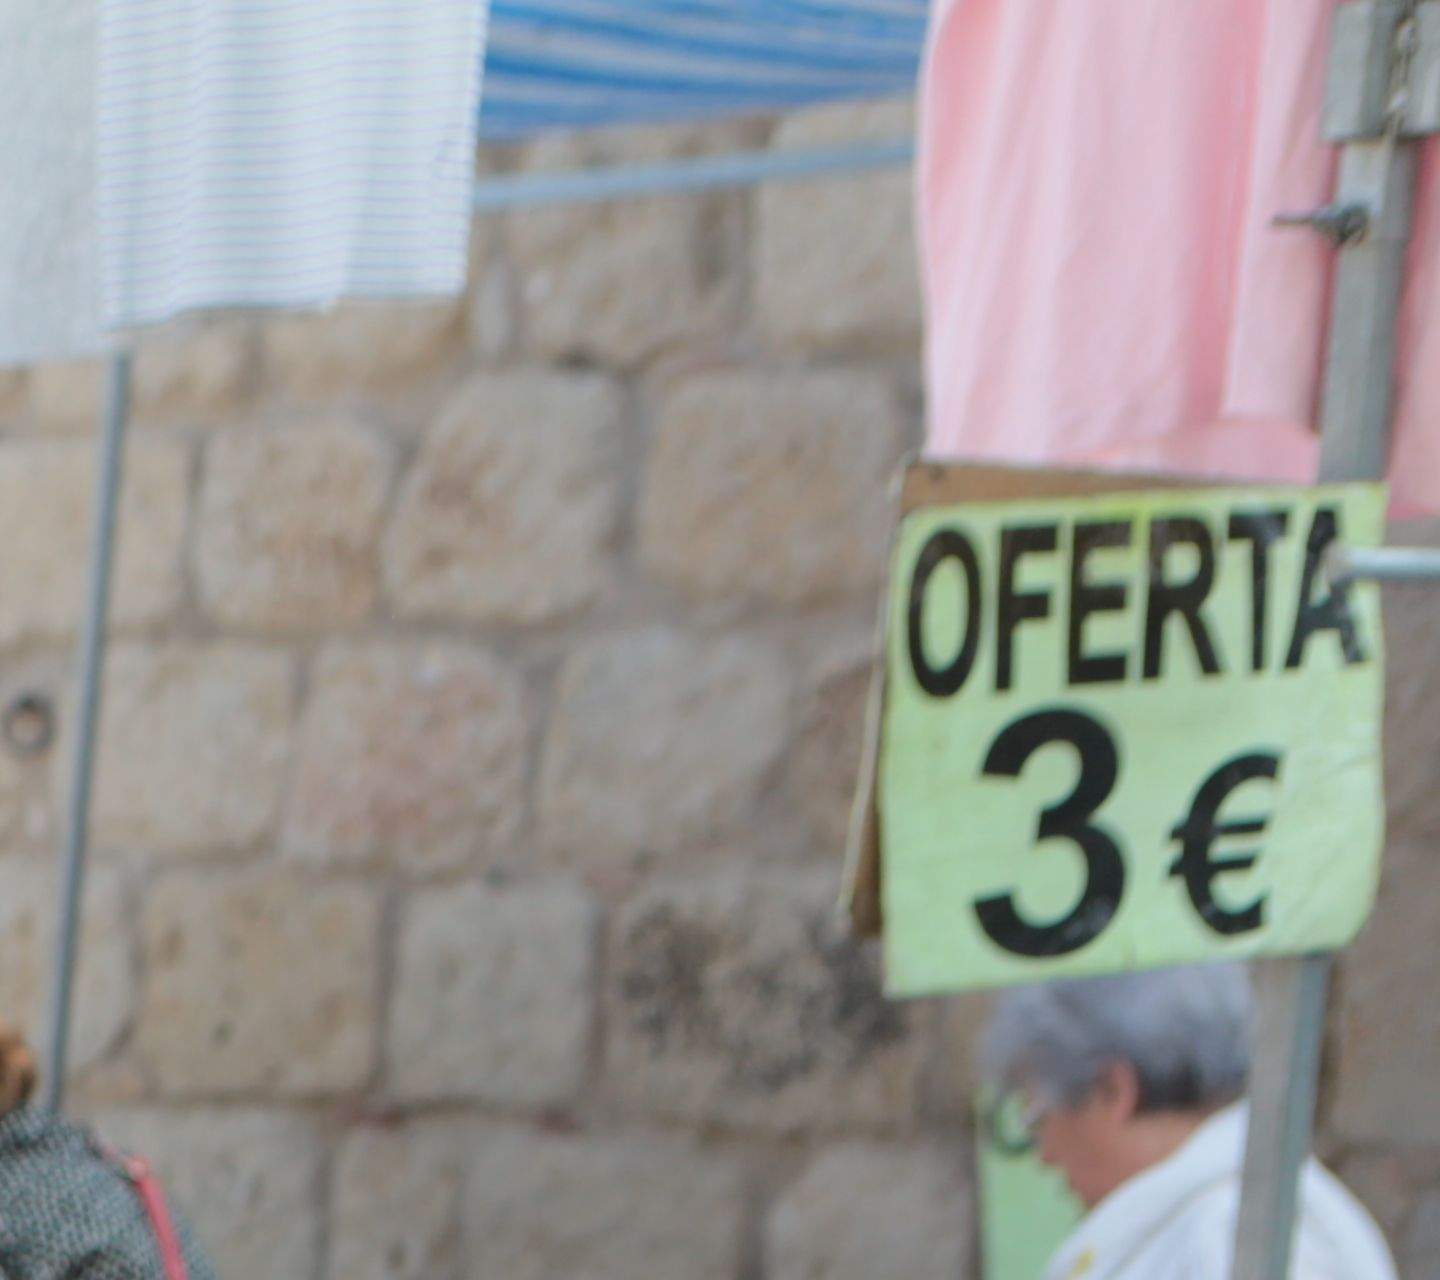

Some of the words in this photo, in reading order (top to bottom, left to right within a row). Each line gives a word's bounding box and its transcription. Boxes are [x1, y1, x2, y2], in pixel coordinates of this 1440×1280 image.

[907, 506, 1372, 700] OFERTA
[973, 707, 1127, 958] 3
[1167, 751, 1282, 938] €
